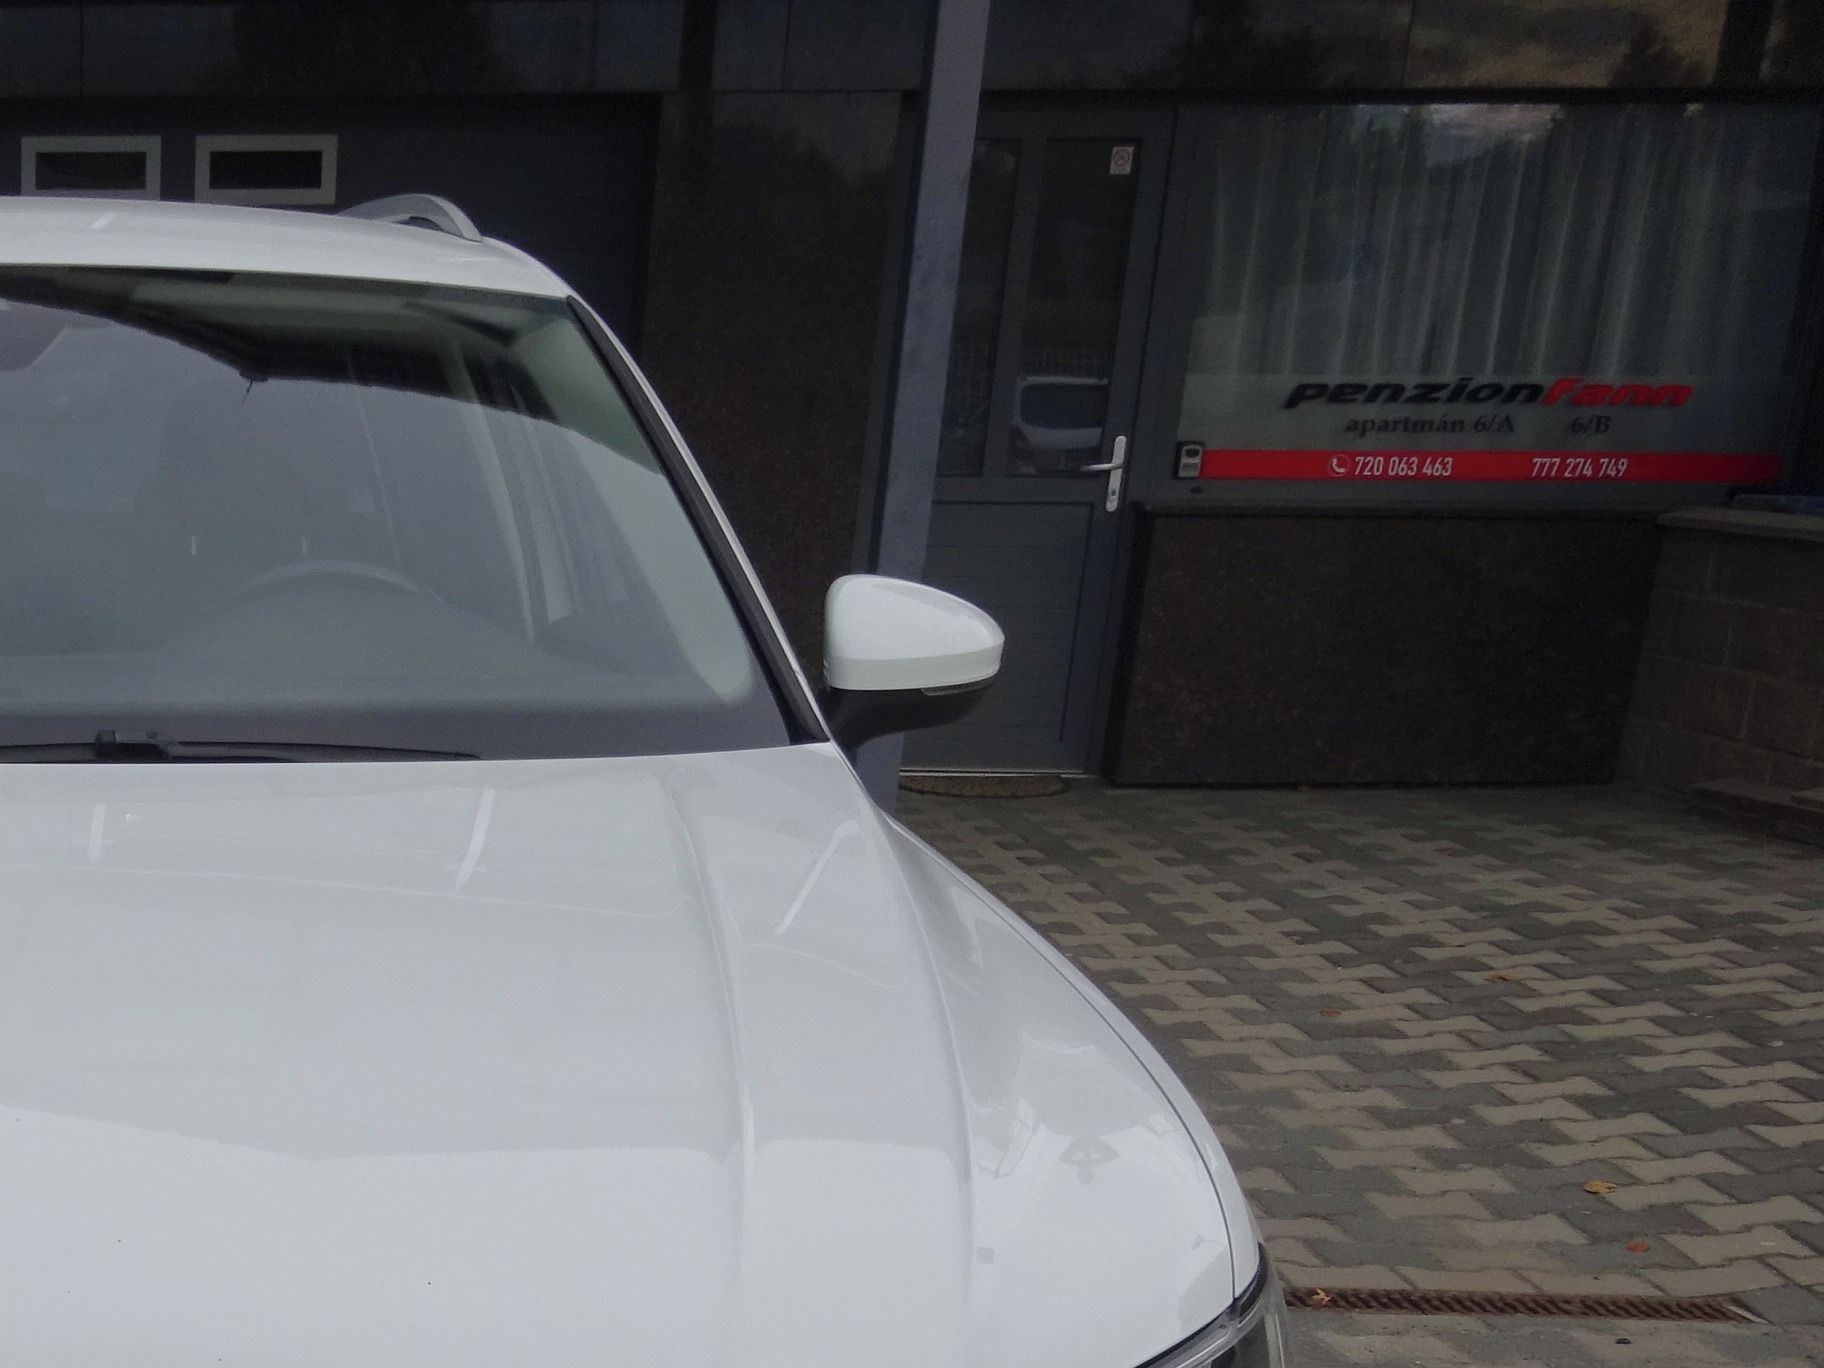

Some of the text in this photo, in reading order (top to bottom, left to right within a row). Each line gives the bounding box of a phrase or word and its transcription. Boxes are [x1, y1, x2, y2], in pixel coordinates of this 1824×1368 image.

[1346, 413, 1466, 438] apartmán
[1472, 414, 1514, 433] 6/A
[1354, 456, 1454, 477] 720 063 463
[1531, 457, 1629, 478] 777 274 749
